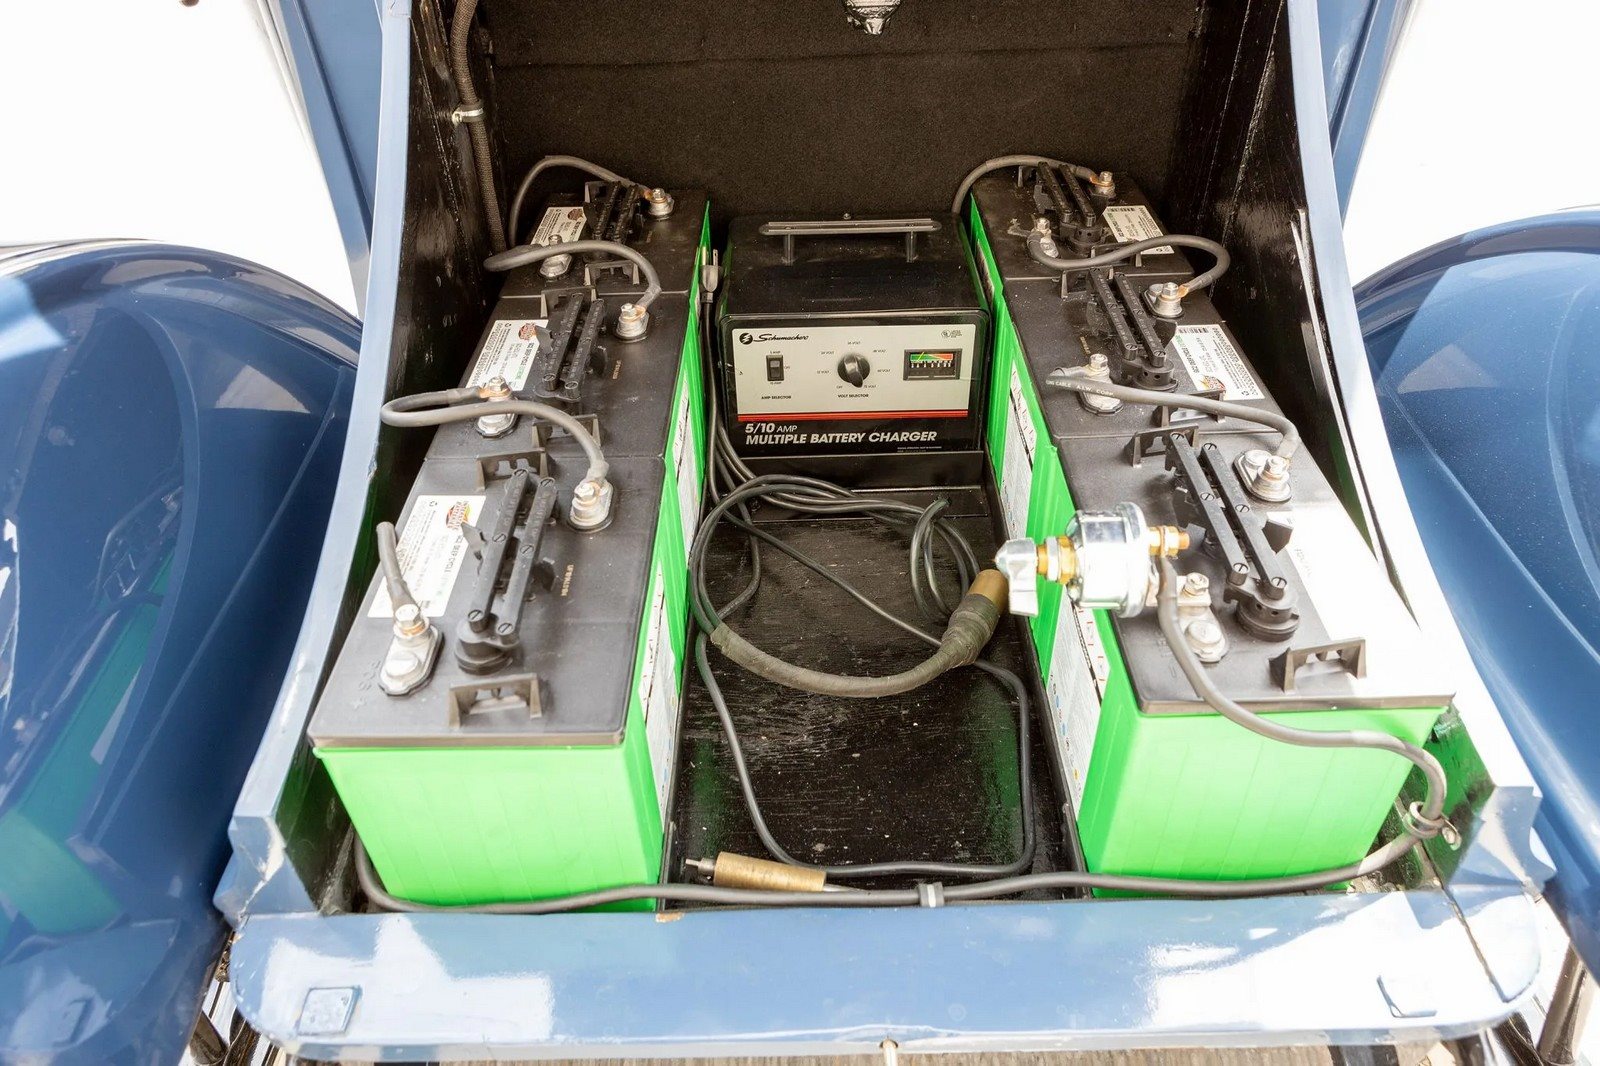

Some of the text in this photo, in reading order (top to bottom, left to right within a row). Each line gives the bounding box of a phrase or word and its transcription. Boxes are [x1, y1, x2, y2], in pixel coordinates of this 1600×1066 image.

[753, 333, 806, 343] Schumacher
[745, 422, 798, 434] 5/10 AMP
[745, 431, 938, 445] MULTIPLE BATTERY CHARGER
